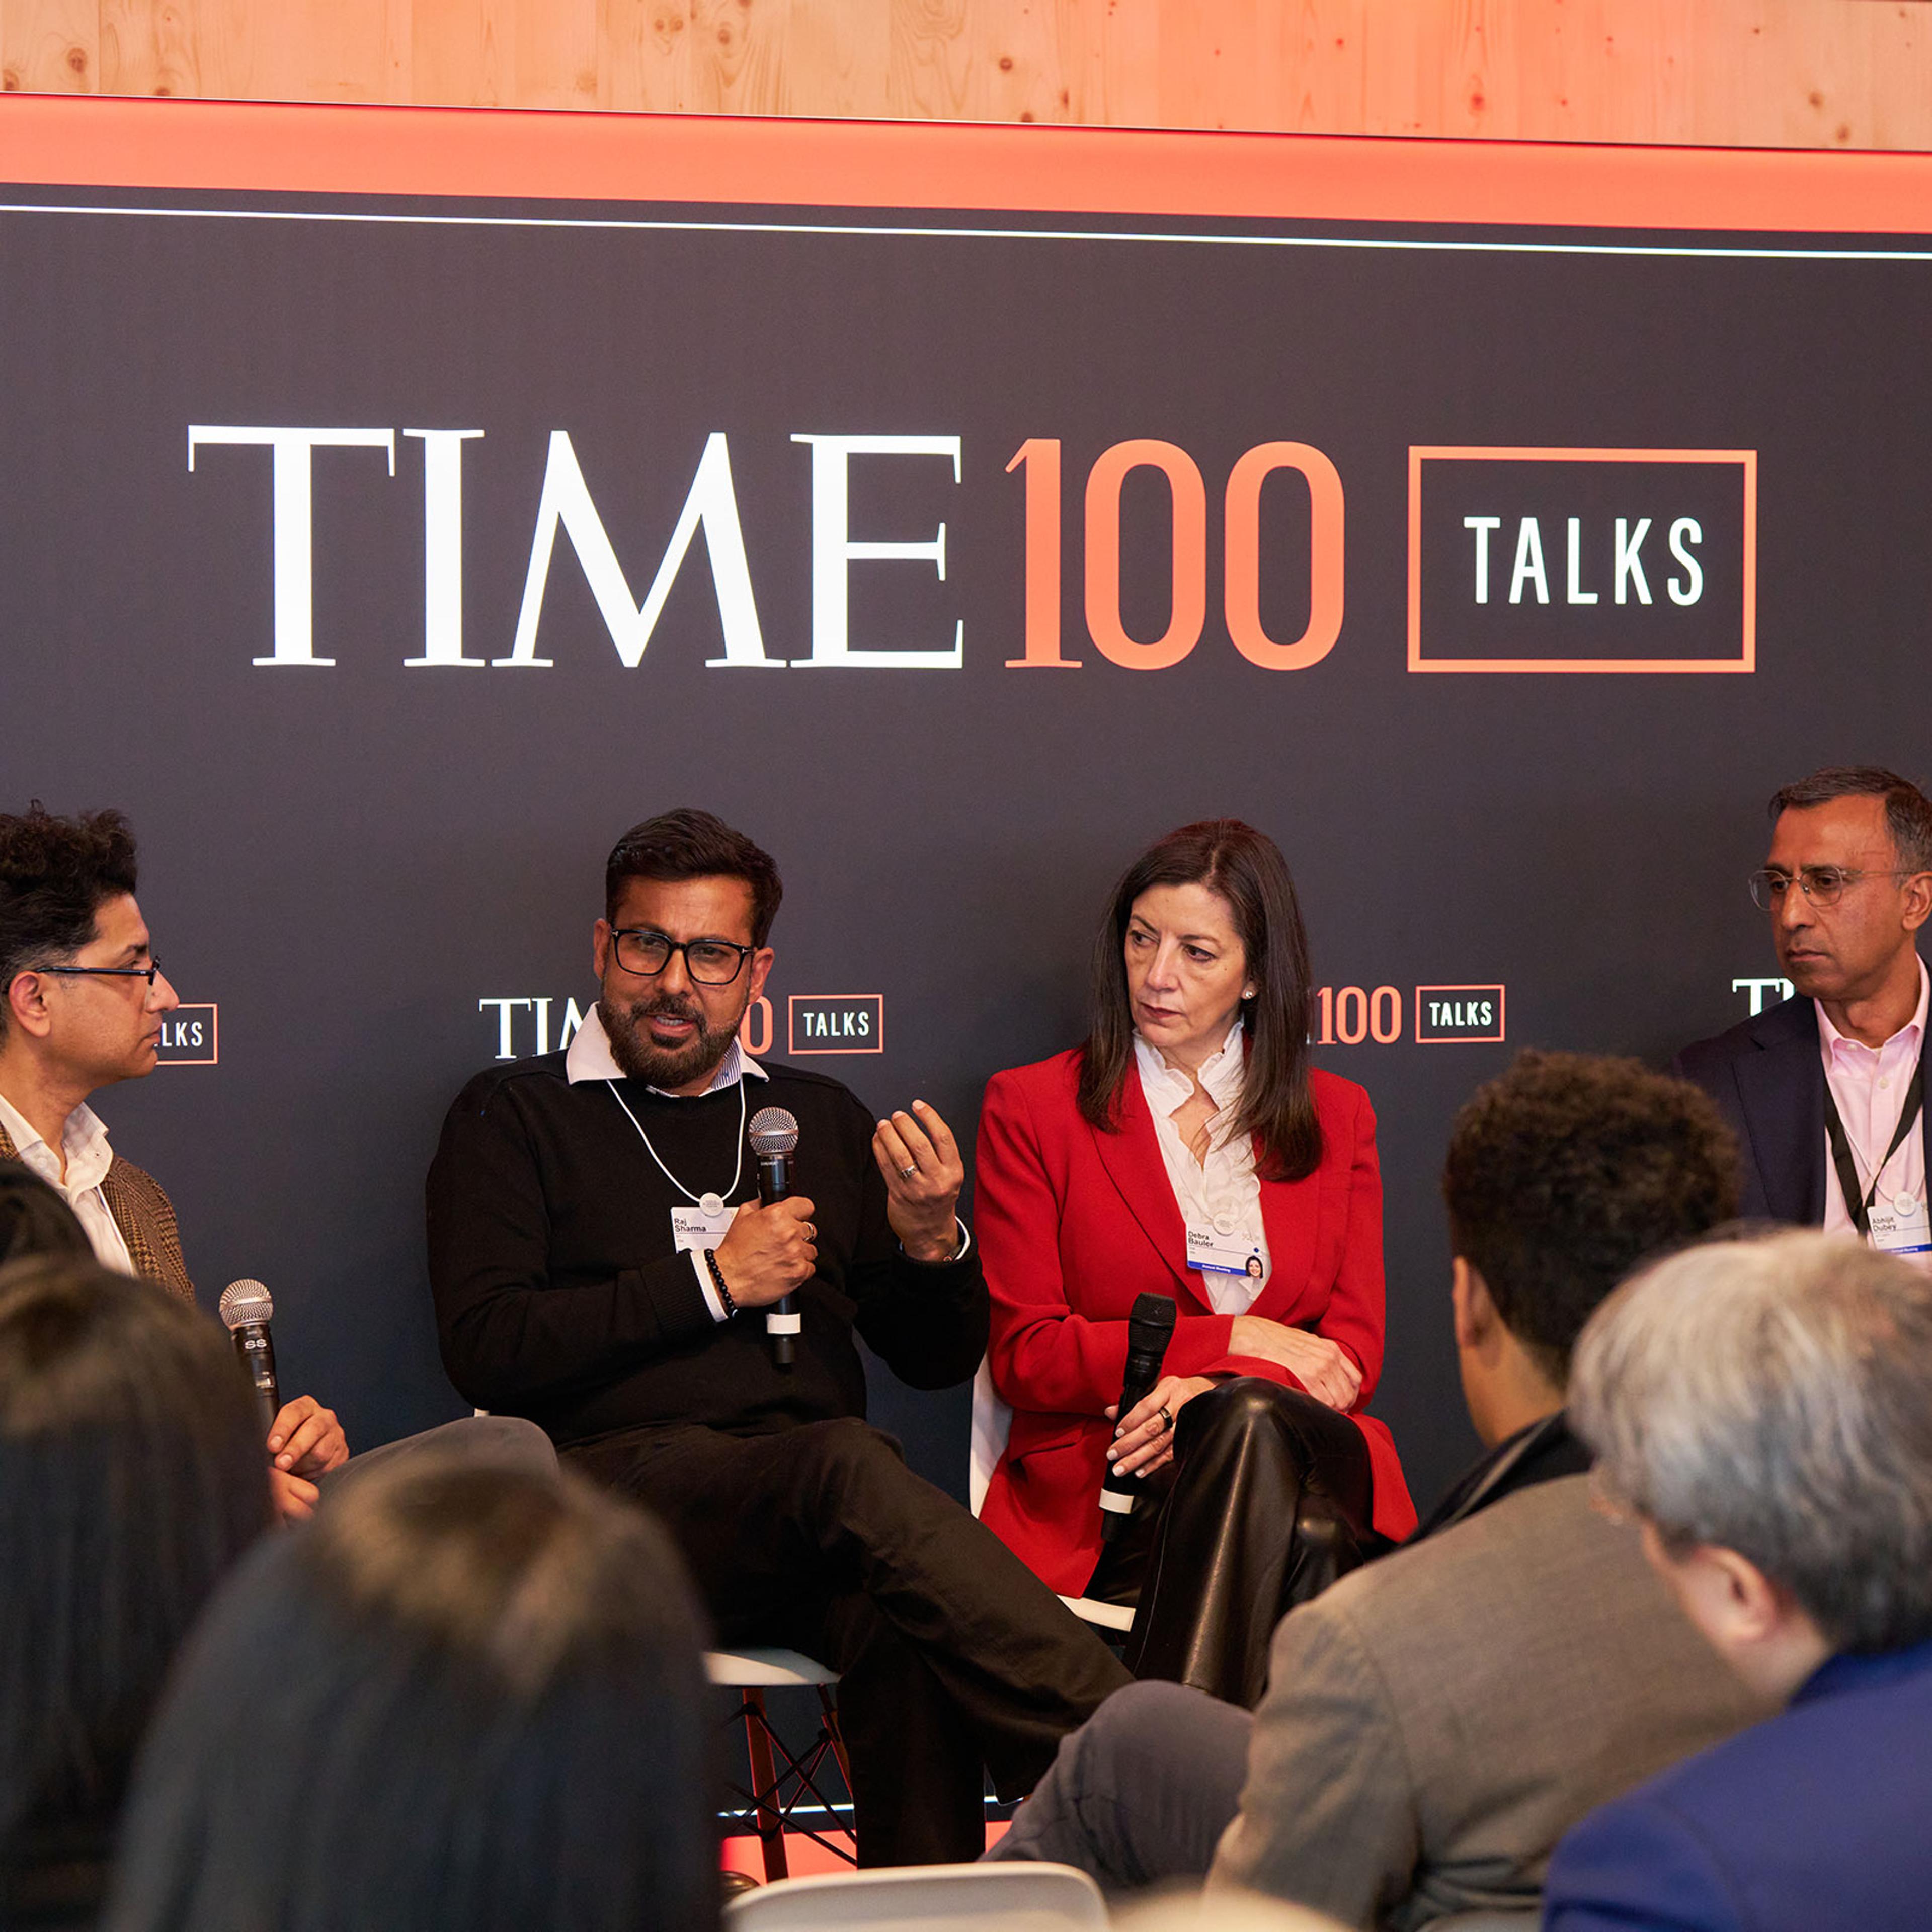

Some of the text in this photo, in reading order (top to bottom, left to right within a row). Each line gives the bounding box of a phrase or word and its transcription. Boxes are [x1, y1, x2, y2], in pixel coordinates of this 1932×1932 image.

[187, 424, 1703, 672] TIME 100 TALKS
[154, 1021, 203, 1047] LKS
[740, 996, 773, 1055] 0
[802, 1011, 870, 1037] TALKS
[1317, 985, 1493, 1045] 100 TALKS
[674, 1218, 687, 1226] Raj
